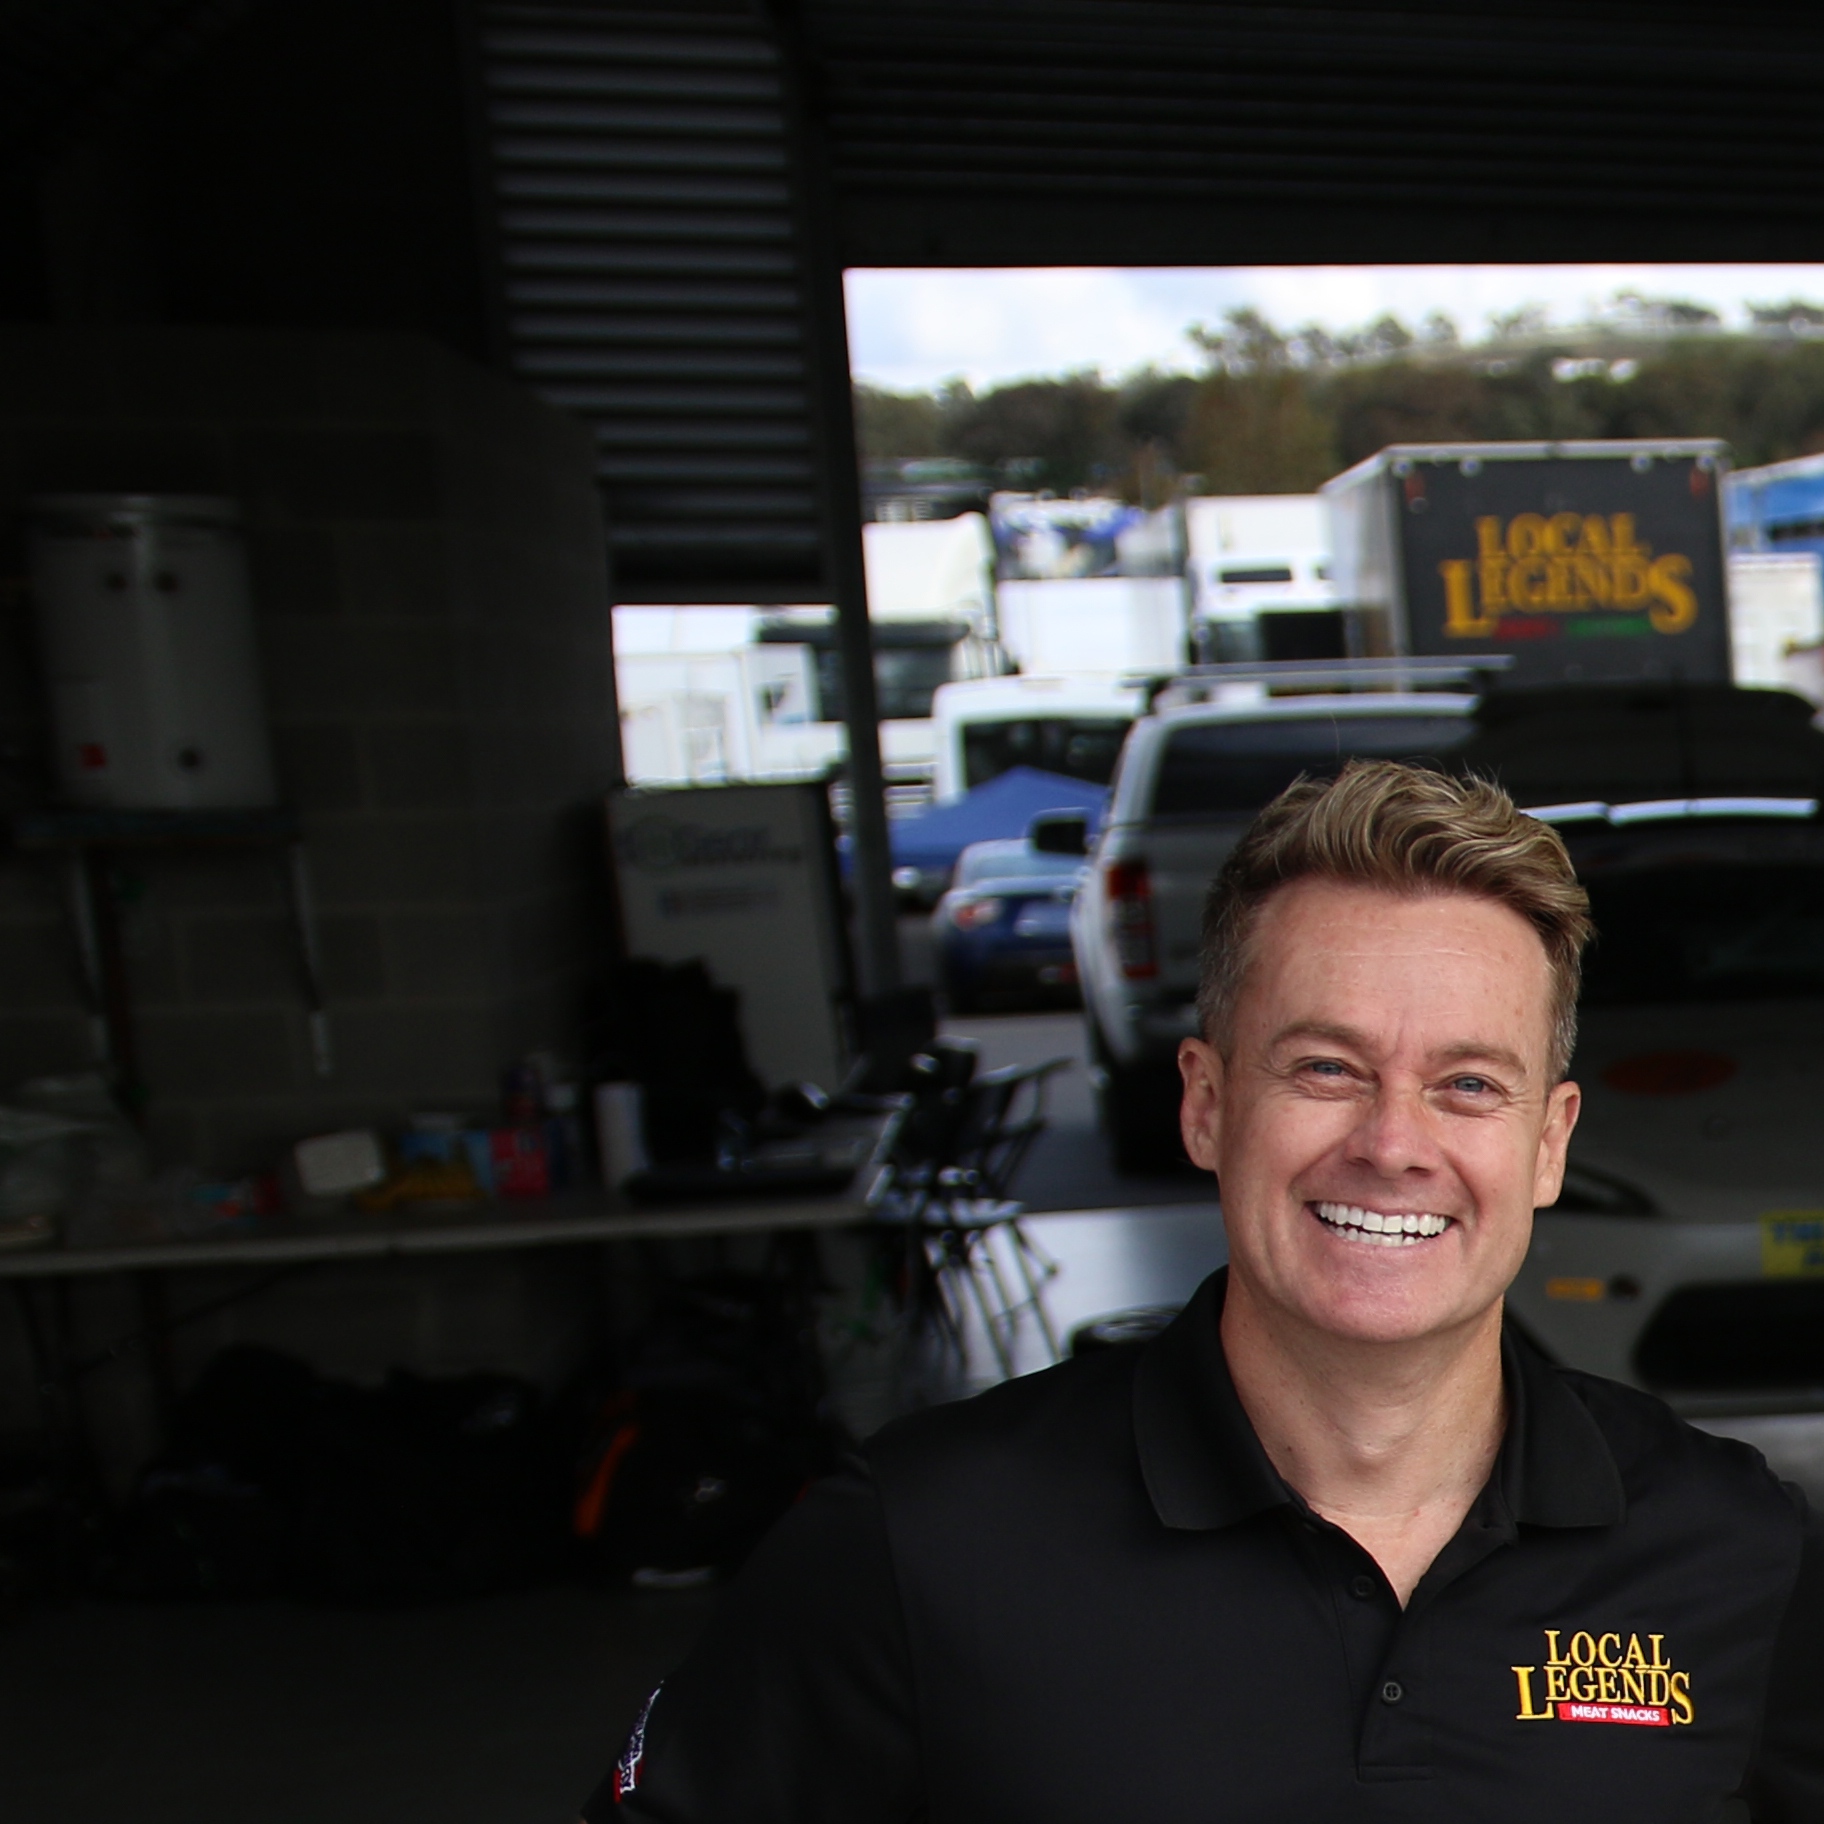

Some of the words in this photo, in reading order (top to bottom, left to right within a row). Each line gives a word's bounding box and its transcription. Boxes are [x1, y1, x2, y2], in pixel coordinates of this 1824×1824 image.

[1476, 511, 1650, 556] LOCAL
[1438, 553, 1698, 639] LEGENDS
[1544, 1629, 1671, 1671] LOCAL
[1511, 1664, 1695, 1725] LEGENDS
[1571, 1704, 1608, 1719] MEAT
[1611, 1707, 1660, 1722] SNACKS
